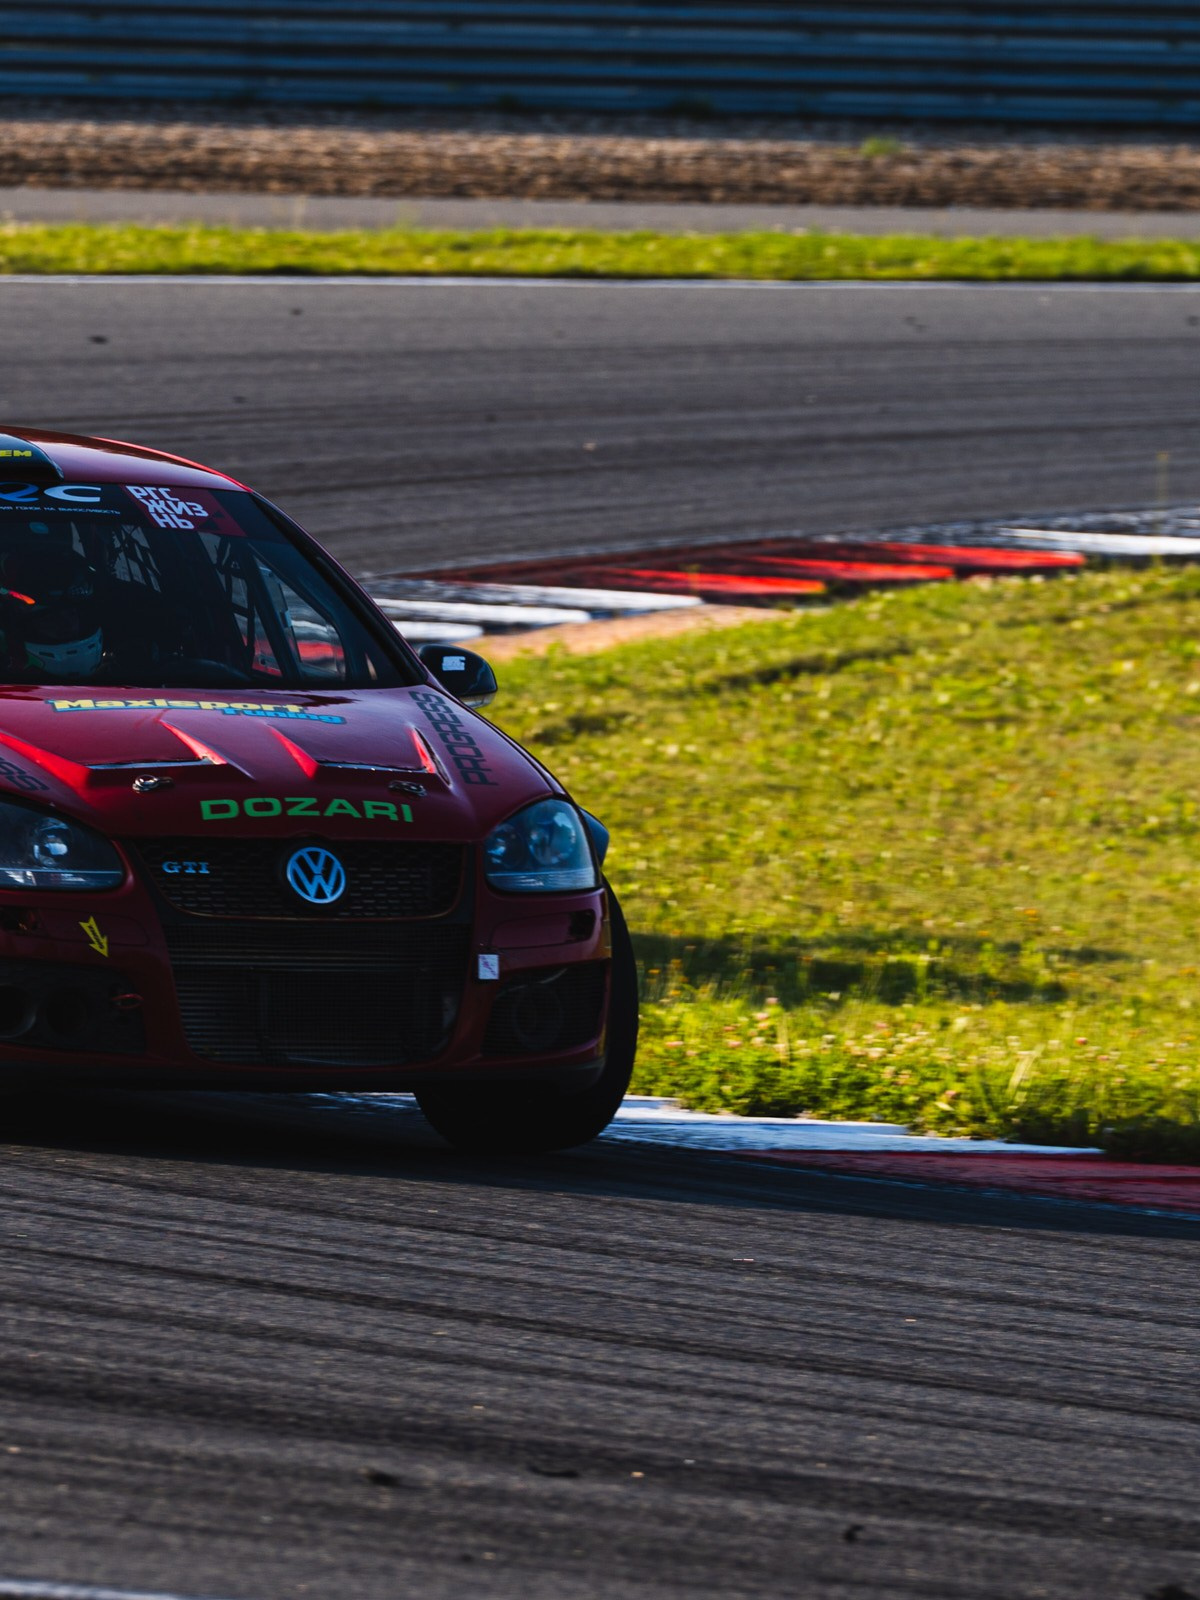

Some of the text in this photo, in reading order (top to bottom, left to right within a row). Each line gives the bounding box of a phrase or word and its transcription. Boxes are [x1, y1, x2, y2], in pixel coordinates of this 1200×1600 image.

[125, 485, 180, 501] РГС
[141, 499, 210, 517] ЖИЗ
[151, 512, 196, 530] НЬ
[50, 698, 306, 714] Maxisport
[222, 708, 344, 724] Tuning
[408, 690, 498, 787] PROGRESS
[200, 797, 414, 823] DOZARI
[161, 860, 211, 874] GTI
